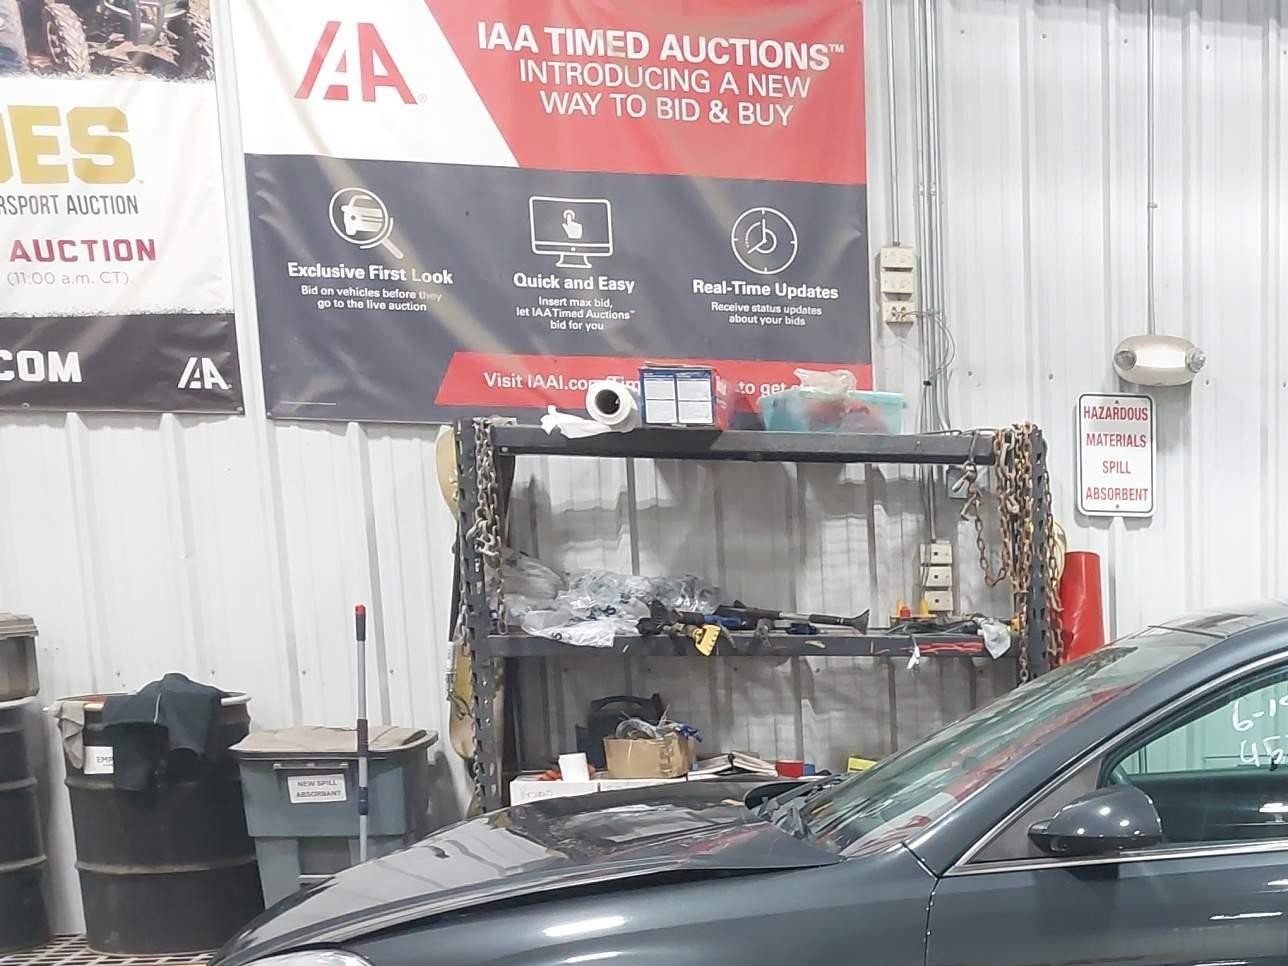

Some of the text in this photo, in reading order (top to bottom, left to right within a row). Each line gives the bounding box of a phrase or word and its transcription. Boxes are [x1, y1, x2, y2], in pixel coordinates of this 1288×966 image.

[478, 21, 538, 54] IAA
[544, 27, 650, 60] TIMED
[519, 58, 811, 98] INTRODUCING A NEW
[540, 90, 794, 127] WAY TO BID & BUY
[0, 105, 136, 185] ES
[66, 194, 139, 215] AUCTION
[9, 239, 157, 262] AUCTION
[7, 271, 56, 286] (11:00
[61, 273, 95, 285] a.m.
[287, 262, 454, 284] Exclusive First Look
[513, 272, 636, 294] Quick and Easy
[692, 279, 840, 300] Real-Time Updates
[301, 285, 318, 295] Bid
[321, 287, 335, 296] on
[336, 287, 381, 298] vehicles
[382, 288, 417, 300] before
[317, 299, 428, 312] go to the live auction
[538, 295, 568, 307] Insert
[569, 298, 592, 307] max
[711, 301, 823, 316] Receive status updates
[516, 306, 530, 317] let
[550, 320, 605, 332] bid for you
[728, 314, 806, 326] about your bids
[483, 372, 524, 389] Visit
[738, 381, 756, 395] to
[760, 382, 787, 398] get
[1083, 405, 1149, 421] HAZARDOUS
[1085, 433, 1147, 448] MATERIALS
[1102, 460, 1132, 474] SPILL
[1085, 487, 1149, 501] ABSORBENT
[316, 779, 338, 787] SPILL
